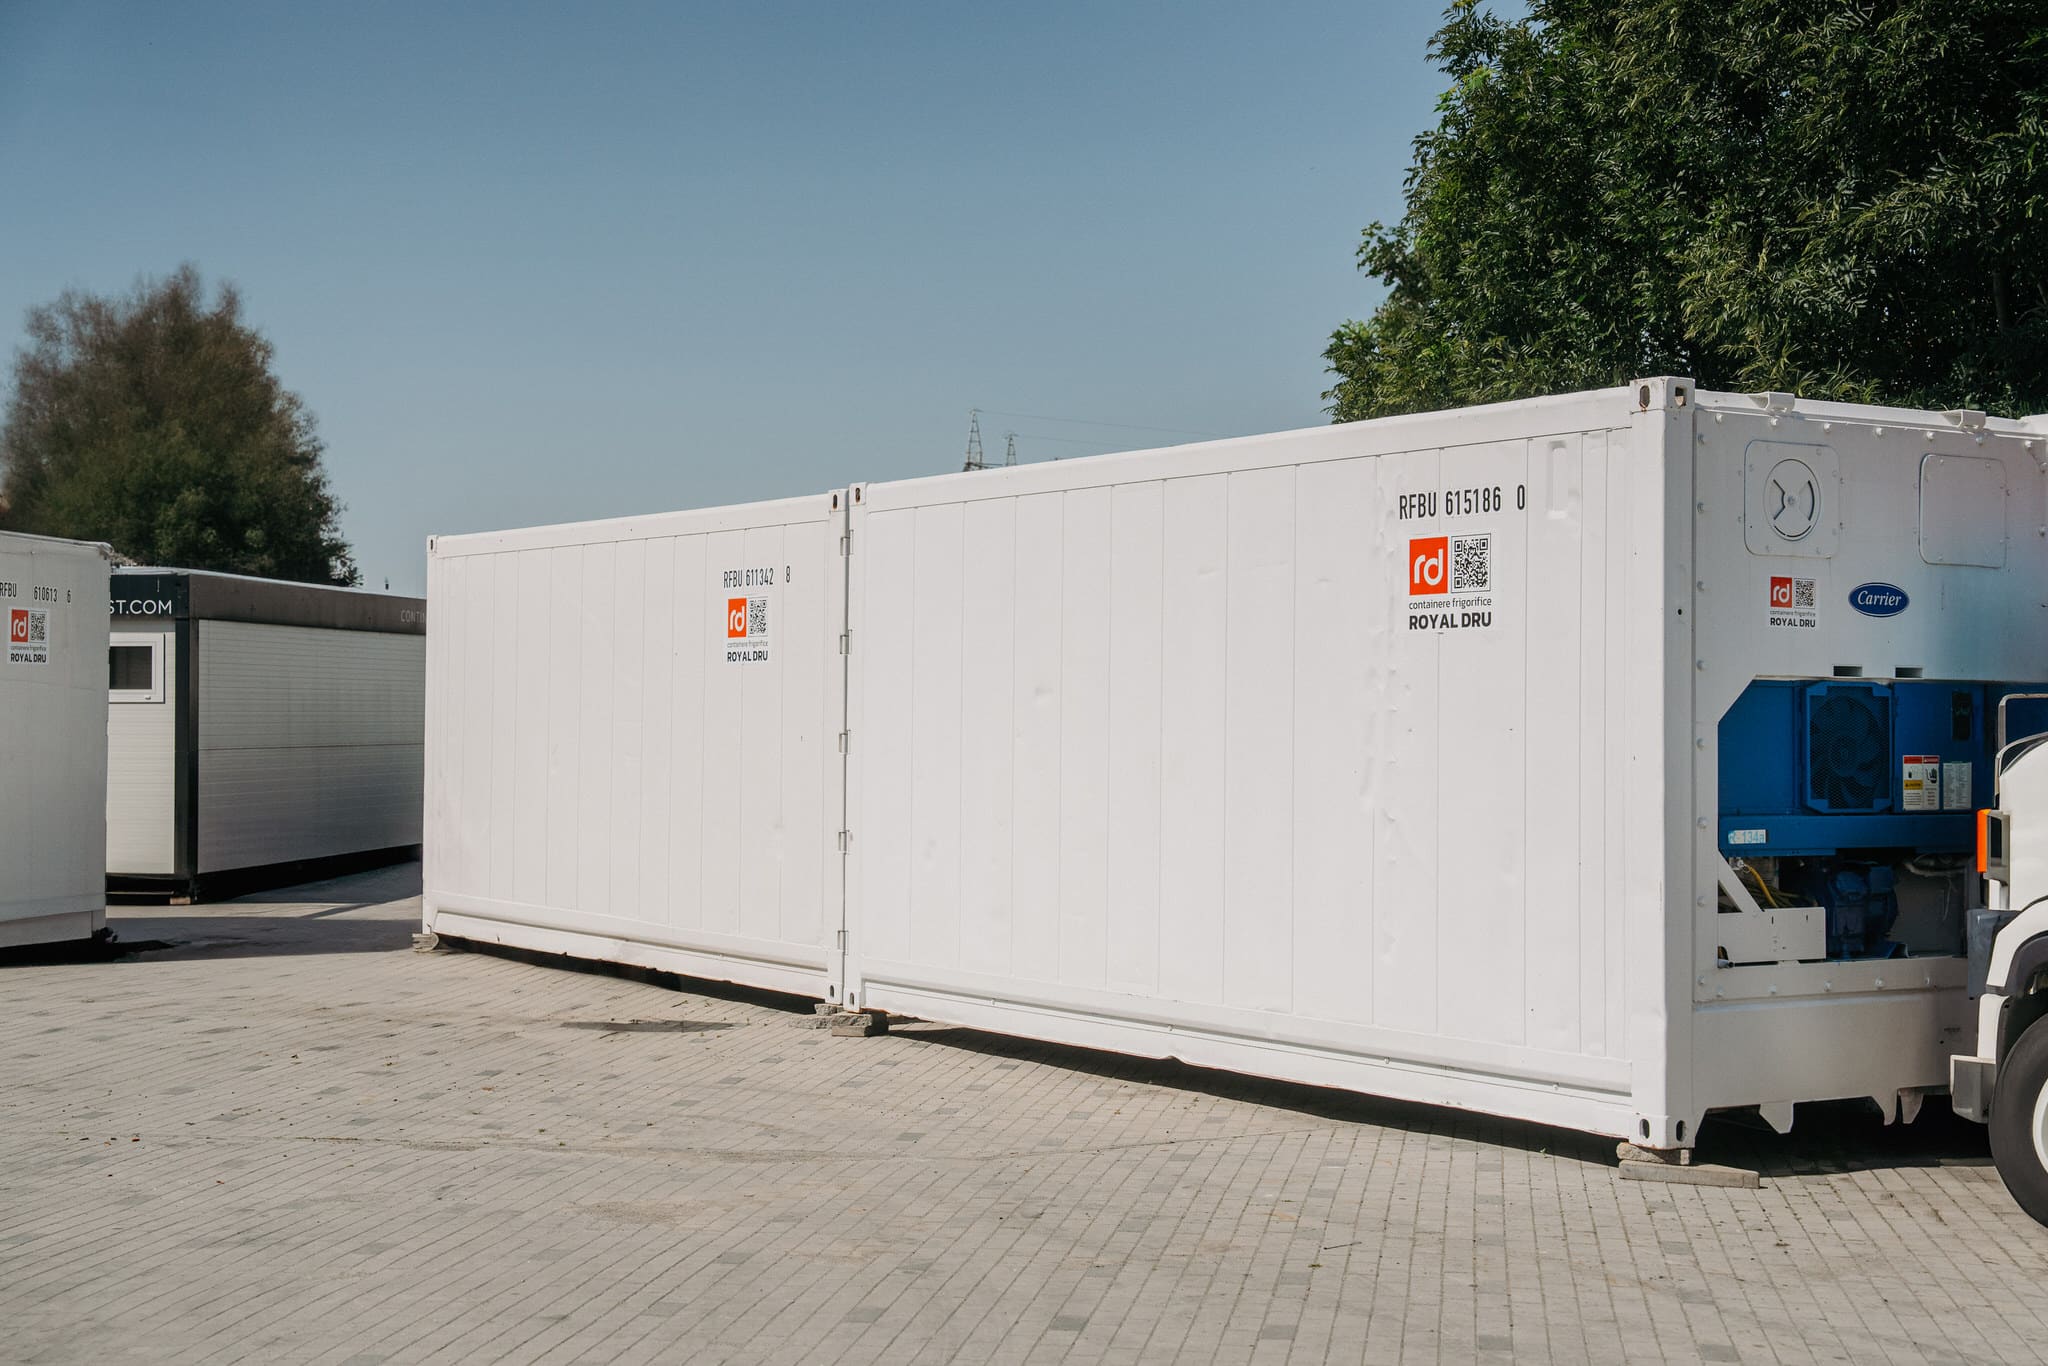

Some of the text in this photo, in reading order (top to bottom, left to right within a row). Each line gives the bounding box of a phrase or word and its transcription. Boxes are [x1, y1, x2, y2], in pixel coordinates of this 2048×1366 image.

[1399, 484, 1525, 520] RFBU 615186 0
[723, 565, 791, 588] RFBU 611342 8
[1414, 548, 1443, 586] rd
[0, 582, 17, 598] RFBU
[33, 586, 58, 603] 610613
[1773, 583, 1790, 603] rd
[1857, 590, 1902, 607] Carrier
[1409, 596, 1492, 610] containere frigorifice
[12, 617, 27, 638] rd
[729, 605, 745, 632] rd
[1409, 611, 1492, 630] ROYAL DRU
[1770, 617, 1816, 628] ROYAL DRU
[10, 653, 47, 663] ROYAL DRU
[727, 650, 768, 662] ROYAL DRU
